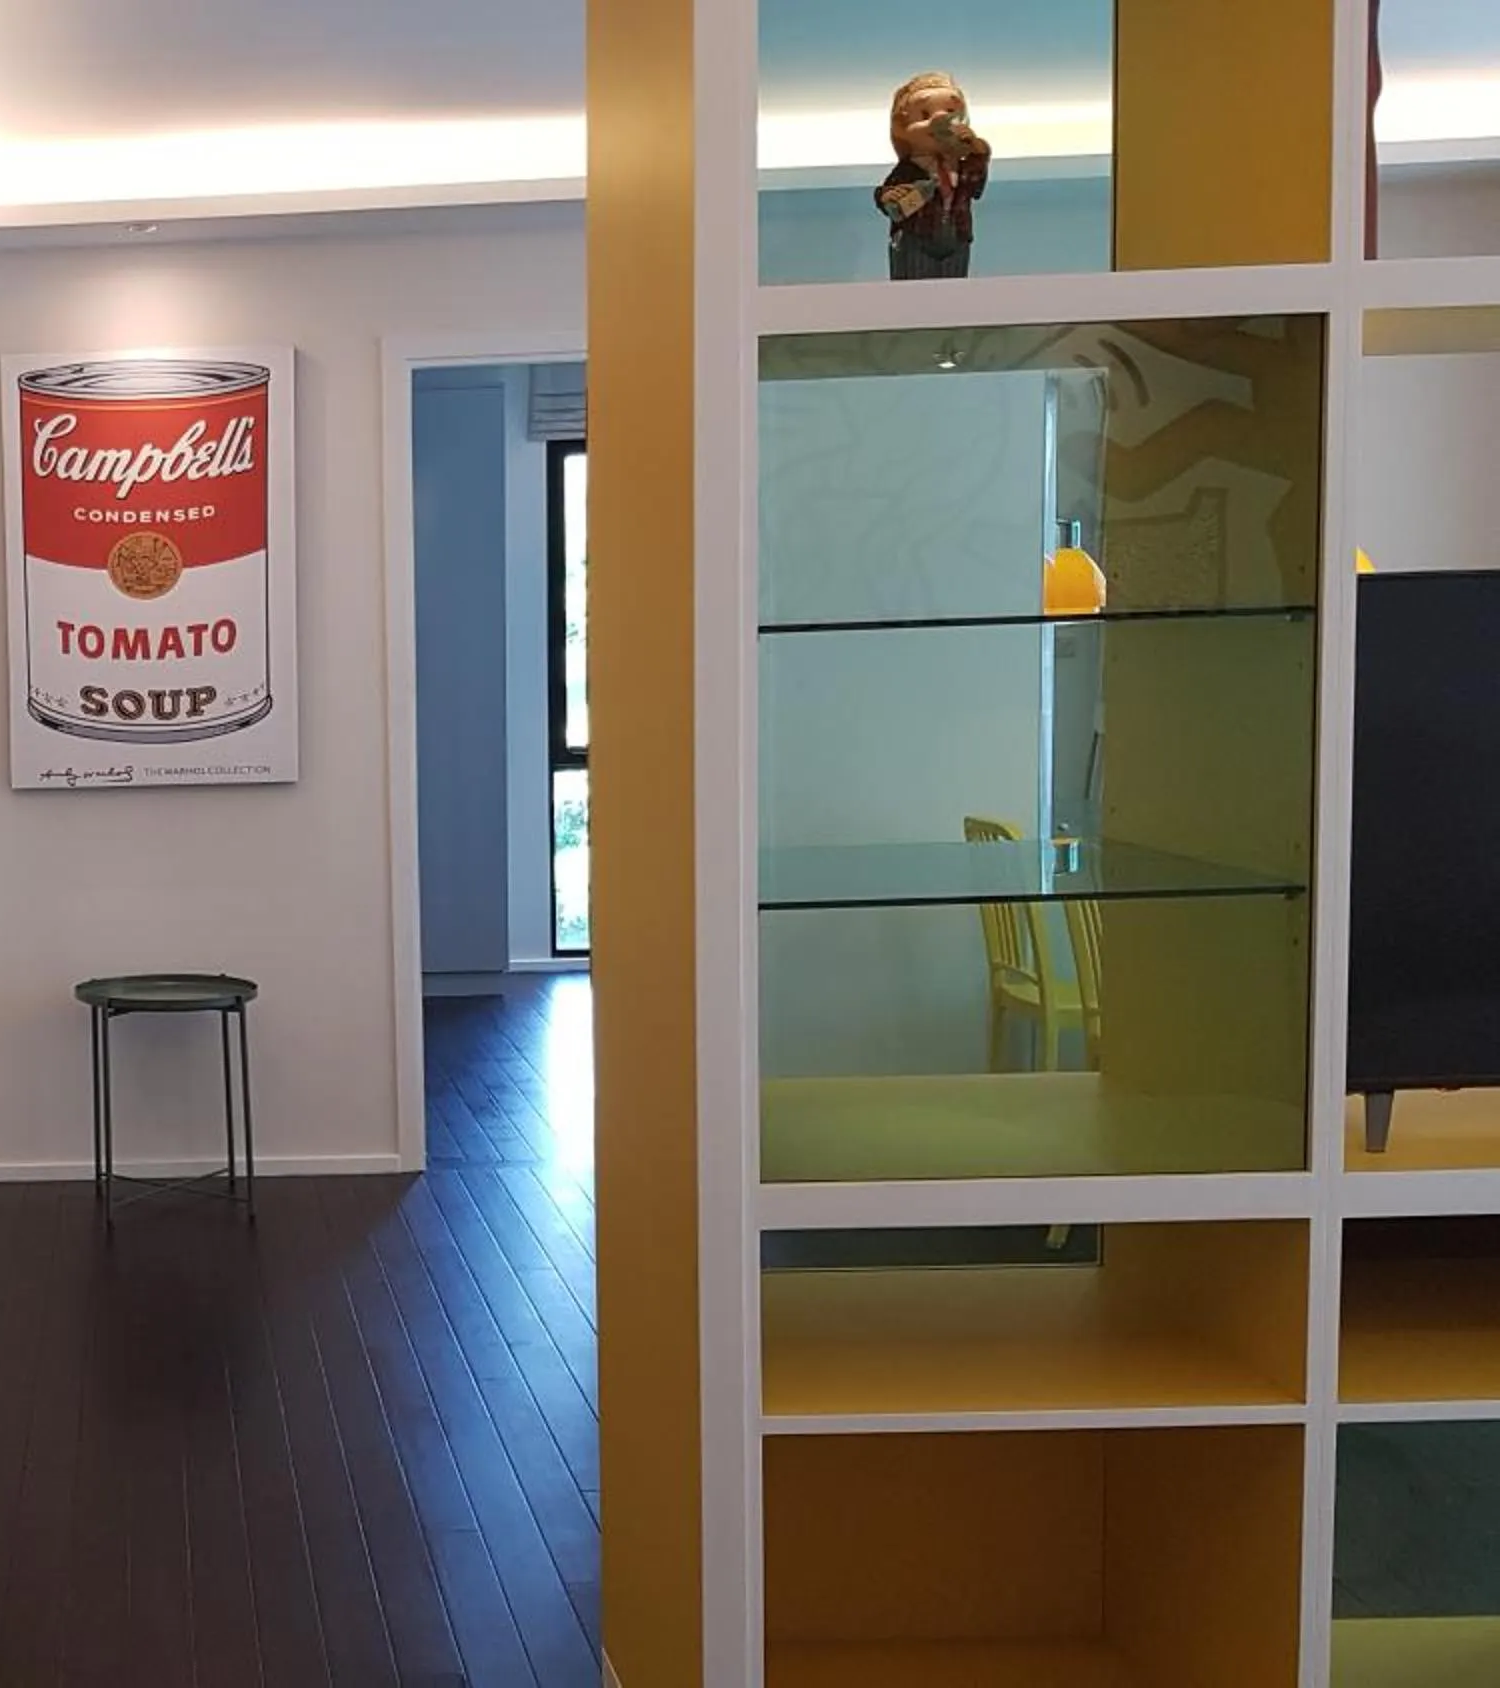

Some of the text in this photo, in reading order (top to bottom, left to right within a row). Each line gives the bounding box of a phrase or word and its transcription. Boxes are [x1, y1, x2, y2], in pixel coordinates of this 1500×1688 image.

[32, 413, 254, 499] Campbell's
[73, 505, 216, 523] CONDENSED
[57, 618, 238, 661] TOMATO
[79, 685, 218, 720] SOUP
